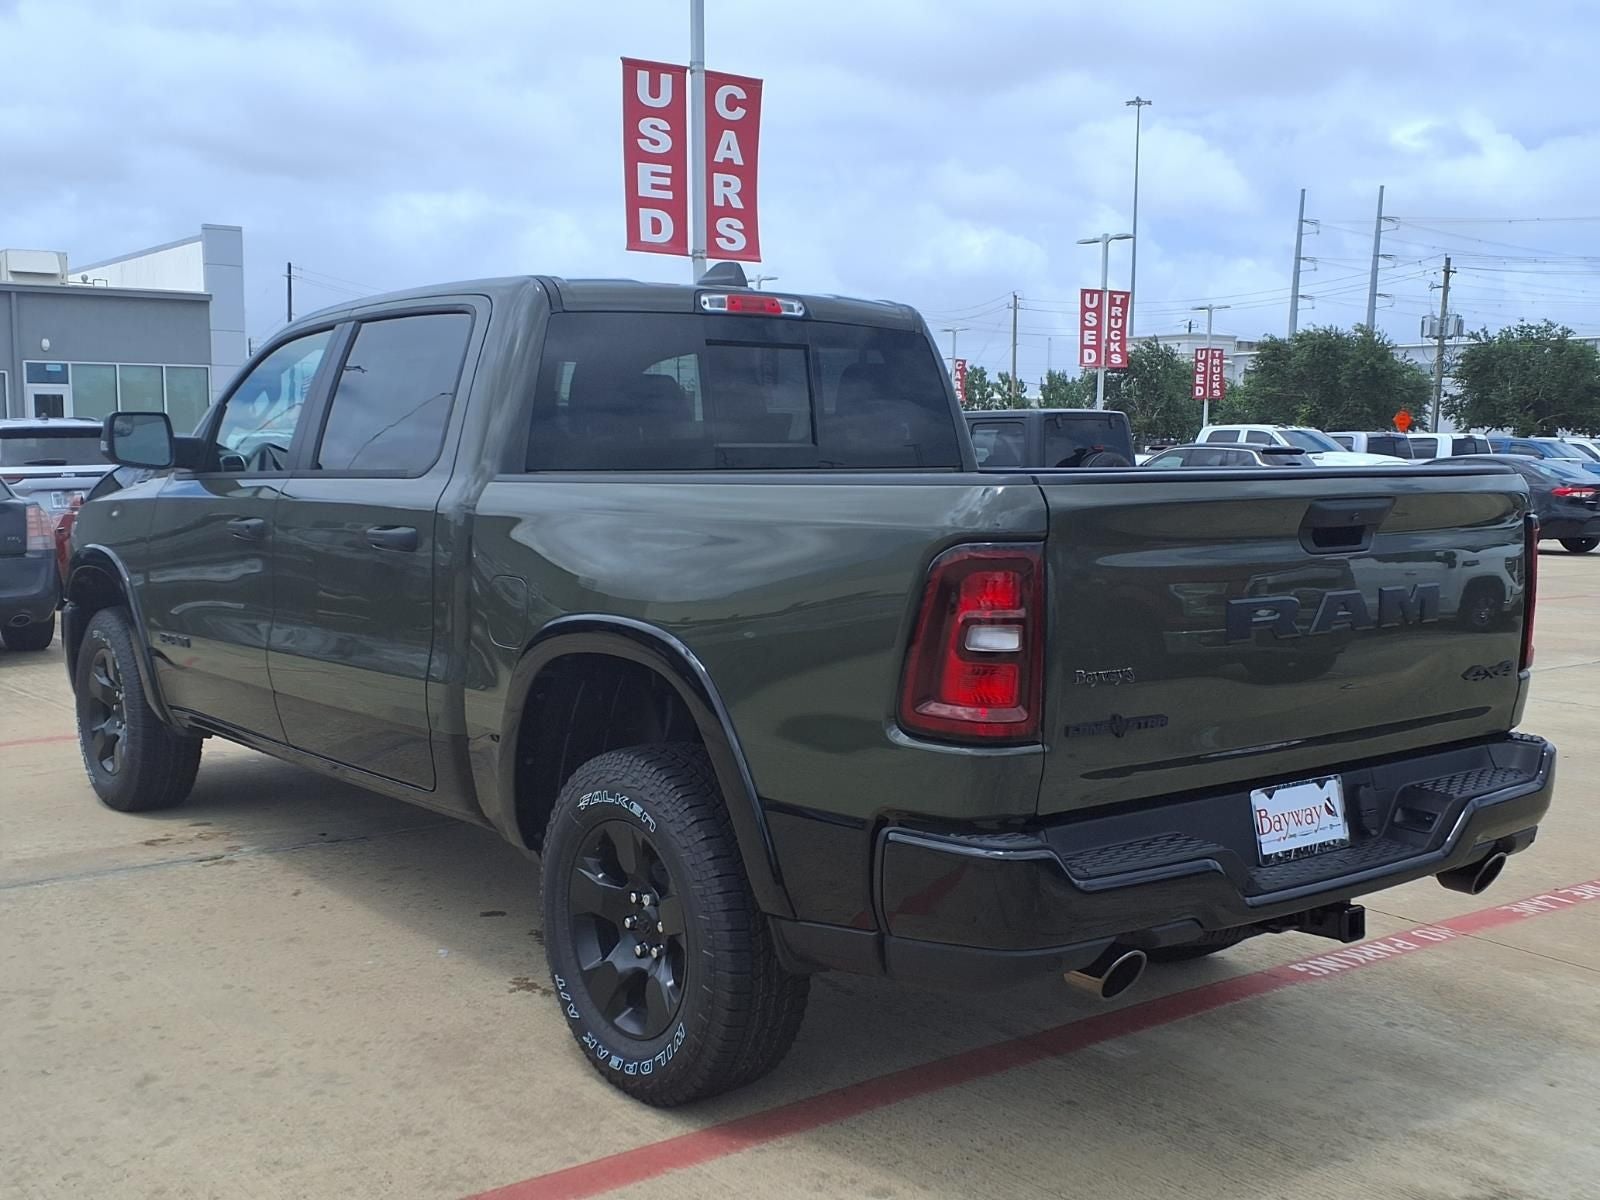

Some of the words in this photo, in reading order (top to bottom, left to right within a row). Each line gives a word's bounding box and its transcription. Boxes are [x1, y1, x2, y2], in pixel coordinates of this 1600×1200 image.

[637, 70, 674, 244] USED
[713, 85, 747, 251] CARS
[1083, 293, 1098, 364] USED
[1110, 294, 1125, 364] TRUCKS
[1195, 351, 1206, 396] USED
[1212, 350, 1221, 397] TRUCKS
[1225, 583, 1440, 644] RAM
[577, 790, 656, 833] FALKEN
[1256, 805, 1322, 840] Bayway
[1496, 894, 1576, 917] LANE
[1288, 937, 1421, 976] PARKING
[1410, 926, 1457, 941] NO
[583, 1022, 685, 1075] WILDPEAK
